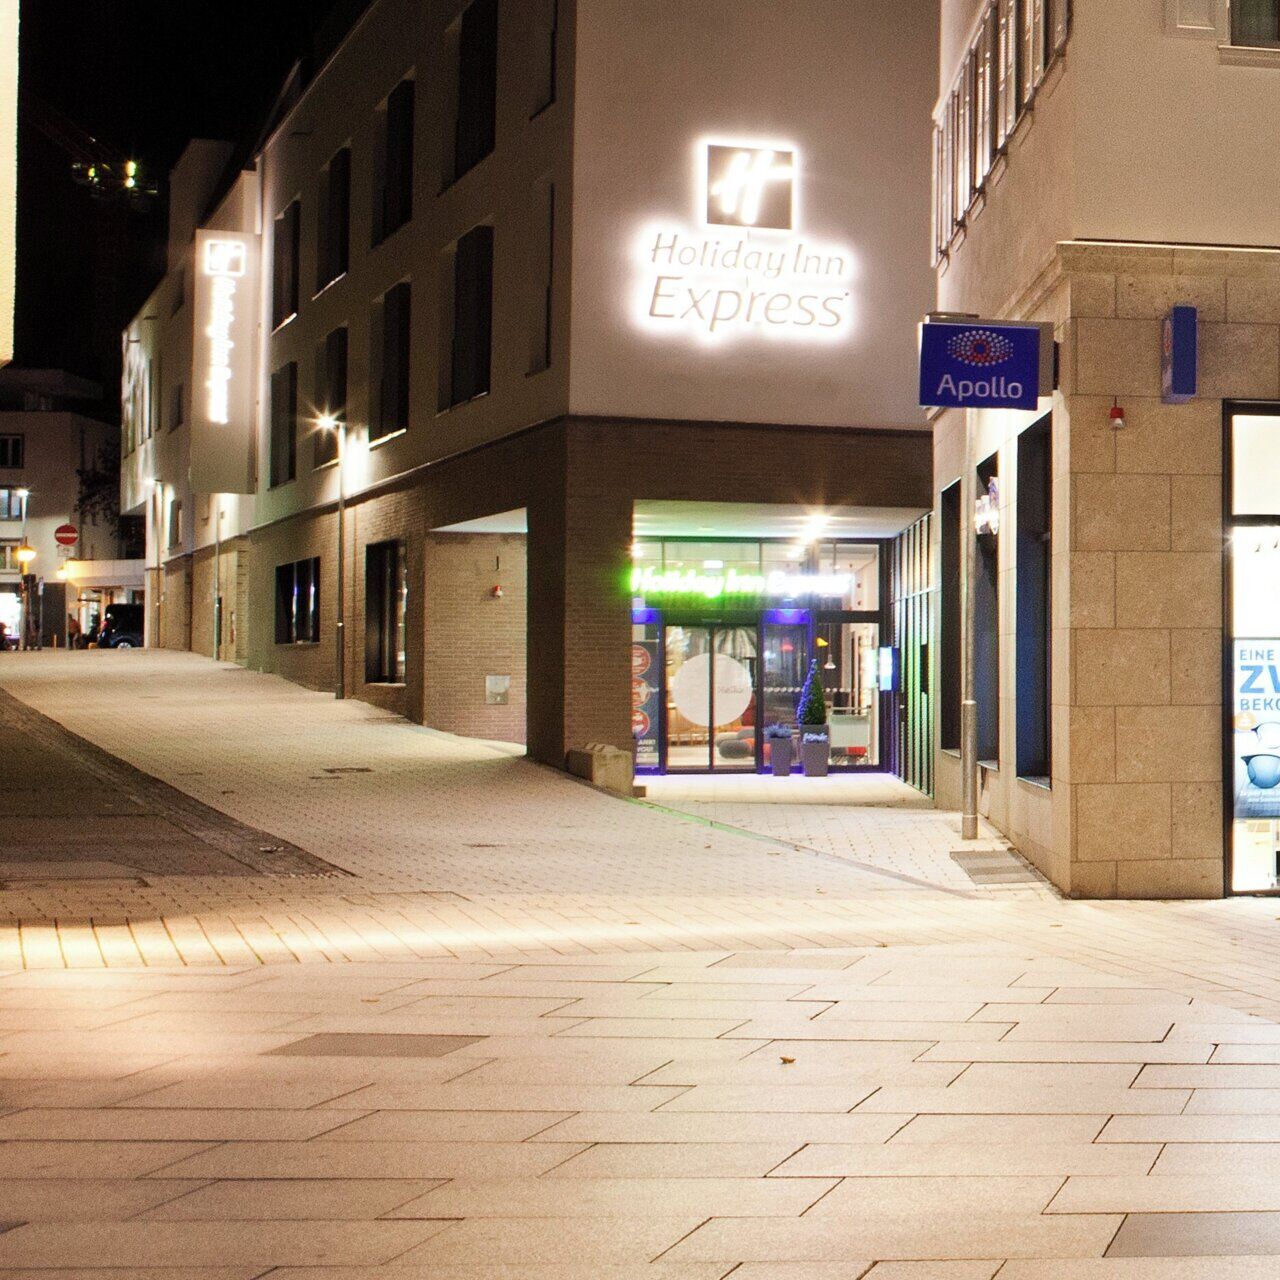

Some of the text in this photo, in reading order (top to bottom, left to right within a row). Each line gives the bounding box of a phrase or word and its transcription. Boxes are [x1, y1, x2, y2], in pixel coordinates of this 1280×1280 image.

[650, 232, 845, 280] Holiday Inn
[648, 275, 850, 333] Express
[936, 373, 1023, 401] Apollo
[1239, 649, 1275, 661] EINE
